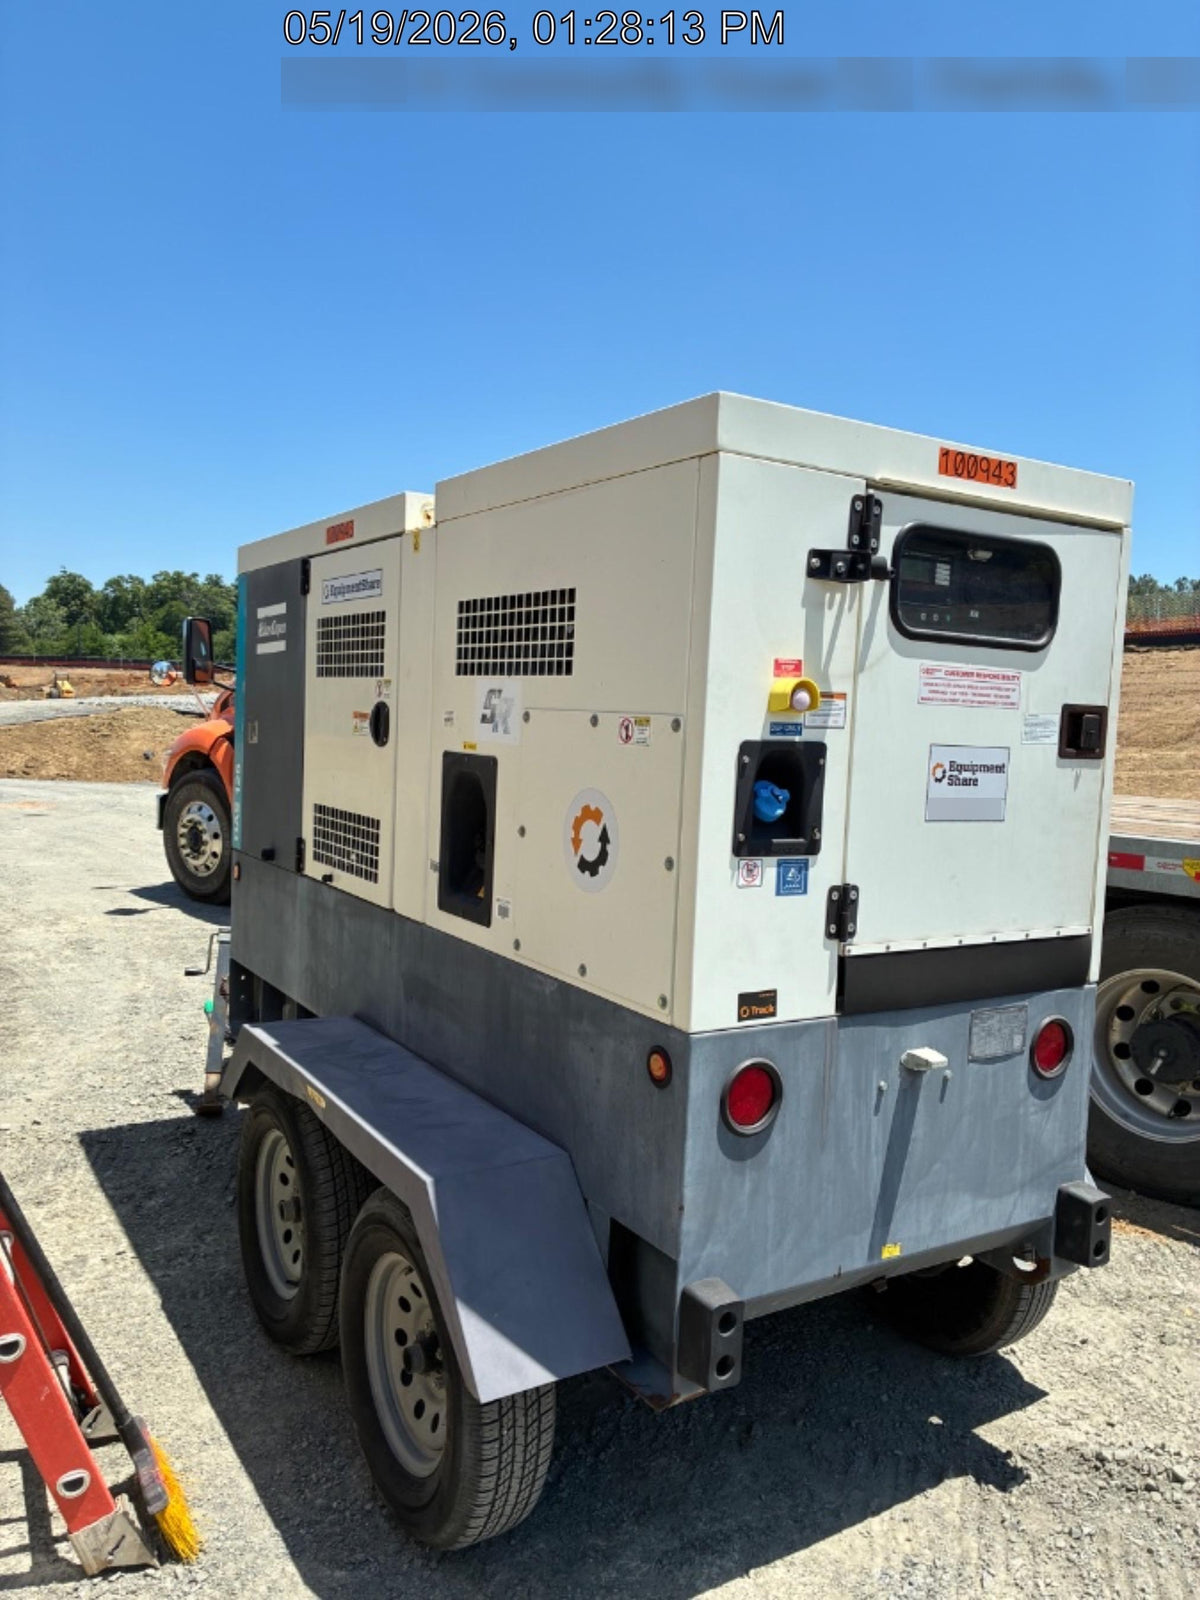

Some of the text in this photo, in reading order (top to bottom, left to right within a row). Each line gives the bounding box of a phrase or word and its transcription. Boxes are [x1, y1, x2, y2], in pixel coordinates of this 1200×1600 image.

[941, 449, 1016, 489] 100943
[949, 760, 1006, 775] Equipment
[947, 774, 979, 787] Share
